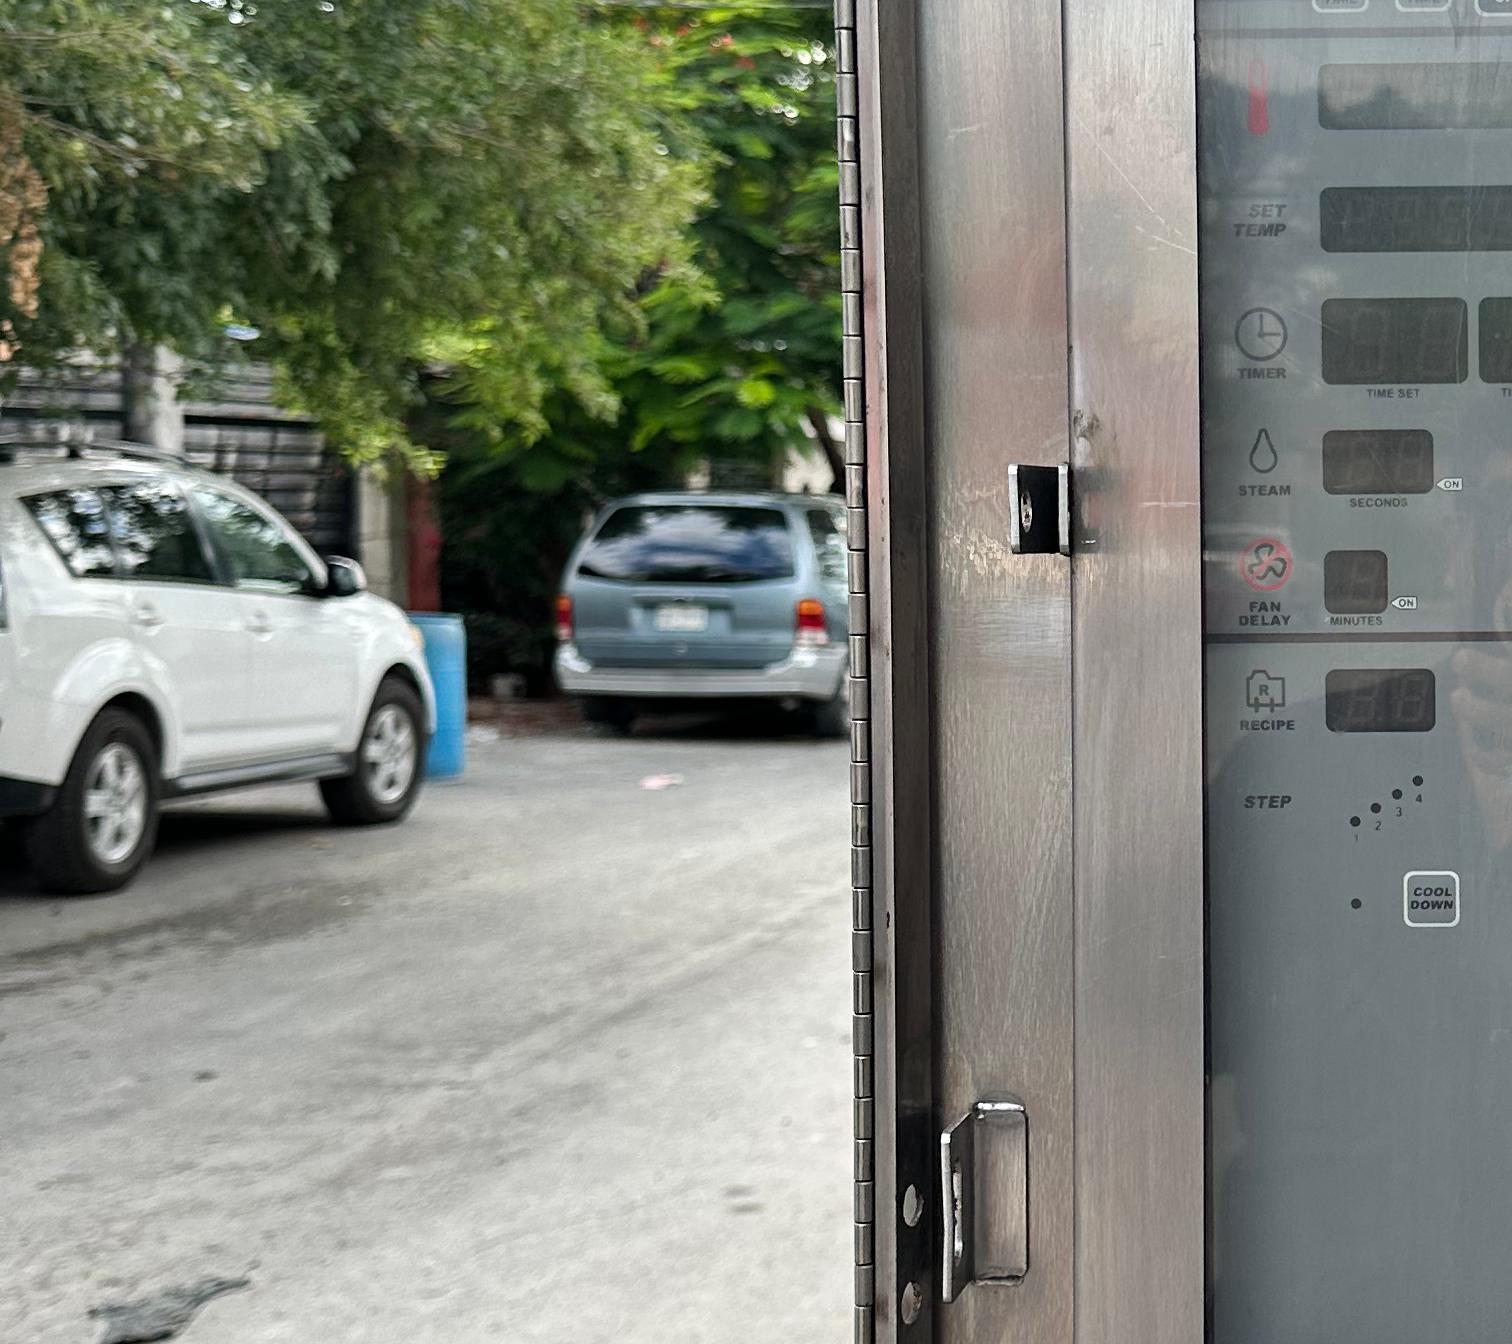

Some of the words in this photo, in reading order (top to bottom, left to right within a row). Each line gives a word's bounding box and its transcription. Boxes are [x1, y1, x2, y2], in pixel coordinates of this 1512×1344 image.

[1249, 204, 1287, 219] SET
[1233, 223, 1287, 238] TEMP
[1237, 367, 1287, 380] TIMER
[1366, 388, 1394, 400] TIME
[1398, 388, 1421, 399] SET
[1443, 479, 1460, 490] ON
[1238, 485, 1291, 497] STEAM
[1349, 497, 1408, 508] SECONDS
[1248, 601, 1282, 613] FAN
[1397, 597, 1415, 608] ON
[1238, 614, 1291, 627] DELAY
[1330, 615, 1383, 627] MINUTES
[1258, 684, 1270, 696] R
[1239, 719, 1295, 732] RECIPE
[1243, 795, 1292, 809] STEP
[1415, 792, 1423, 803] 4
[1395, 806, 1402, 817] 3
[1375, 820, 1382, 832] 2
[1413, 887, 1452, 897] COOL
[1410, 899, 1453, 910] DOWN
